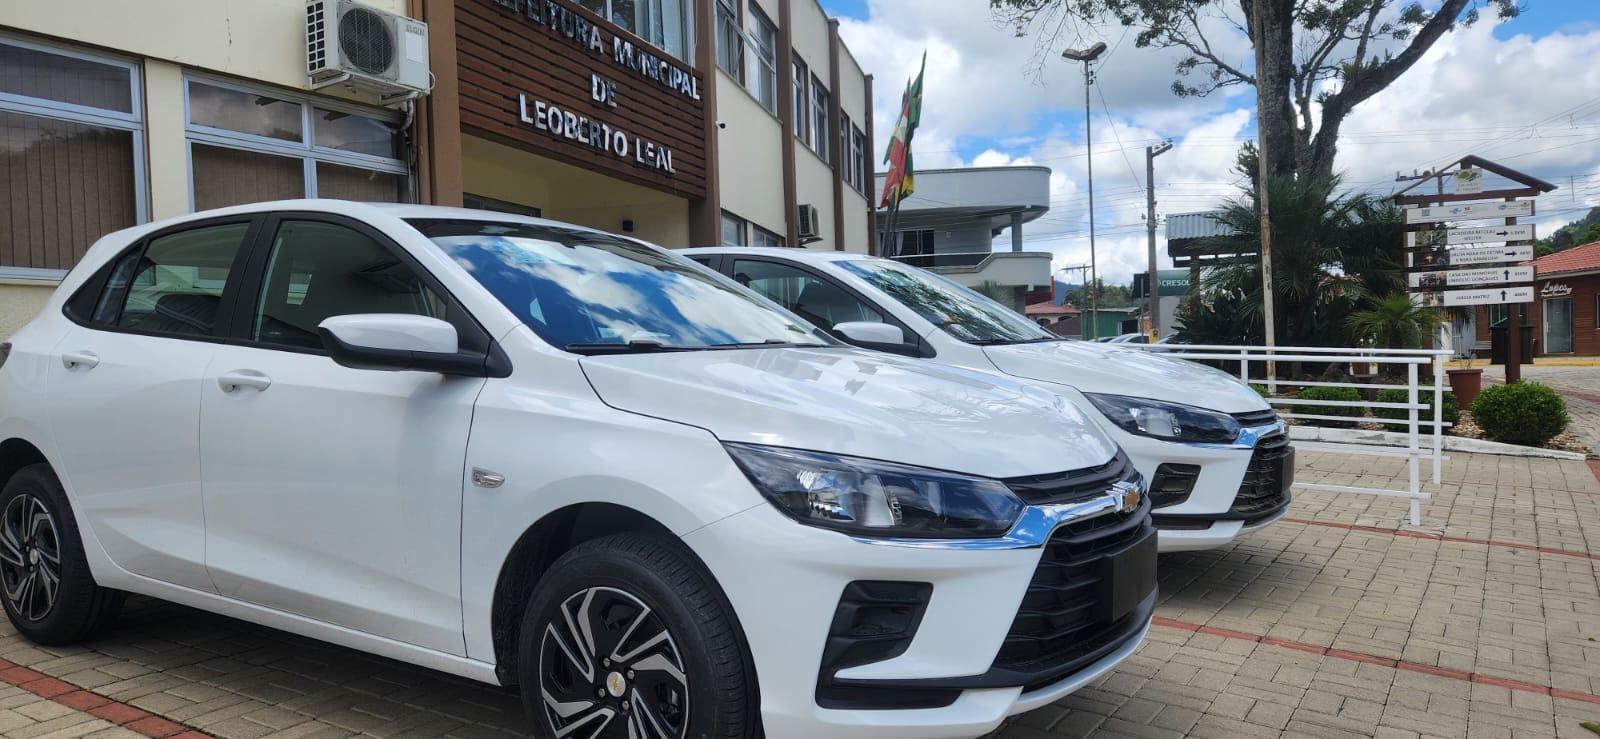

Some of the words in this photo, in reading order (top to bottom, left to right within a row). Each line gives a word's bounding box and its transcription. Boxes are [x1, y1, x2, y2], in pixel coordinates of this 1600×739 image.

[591, 73, 617, 108] DE
[613, 36, 700, 101] MUNICIPAL
[519, 92, 628, 158] LEOBERTO
[635, 137, 676, 174] LEAL
[1161, 279, 1190, 287] CRESOL
